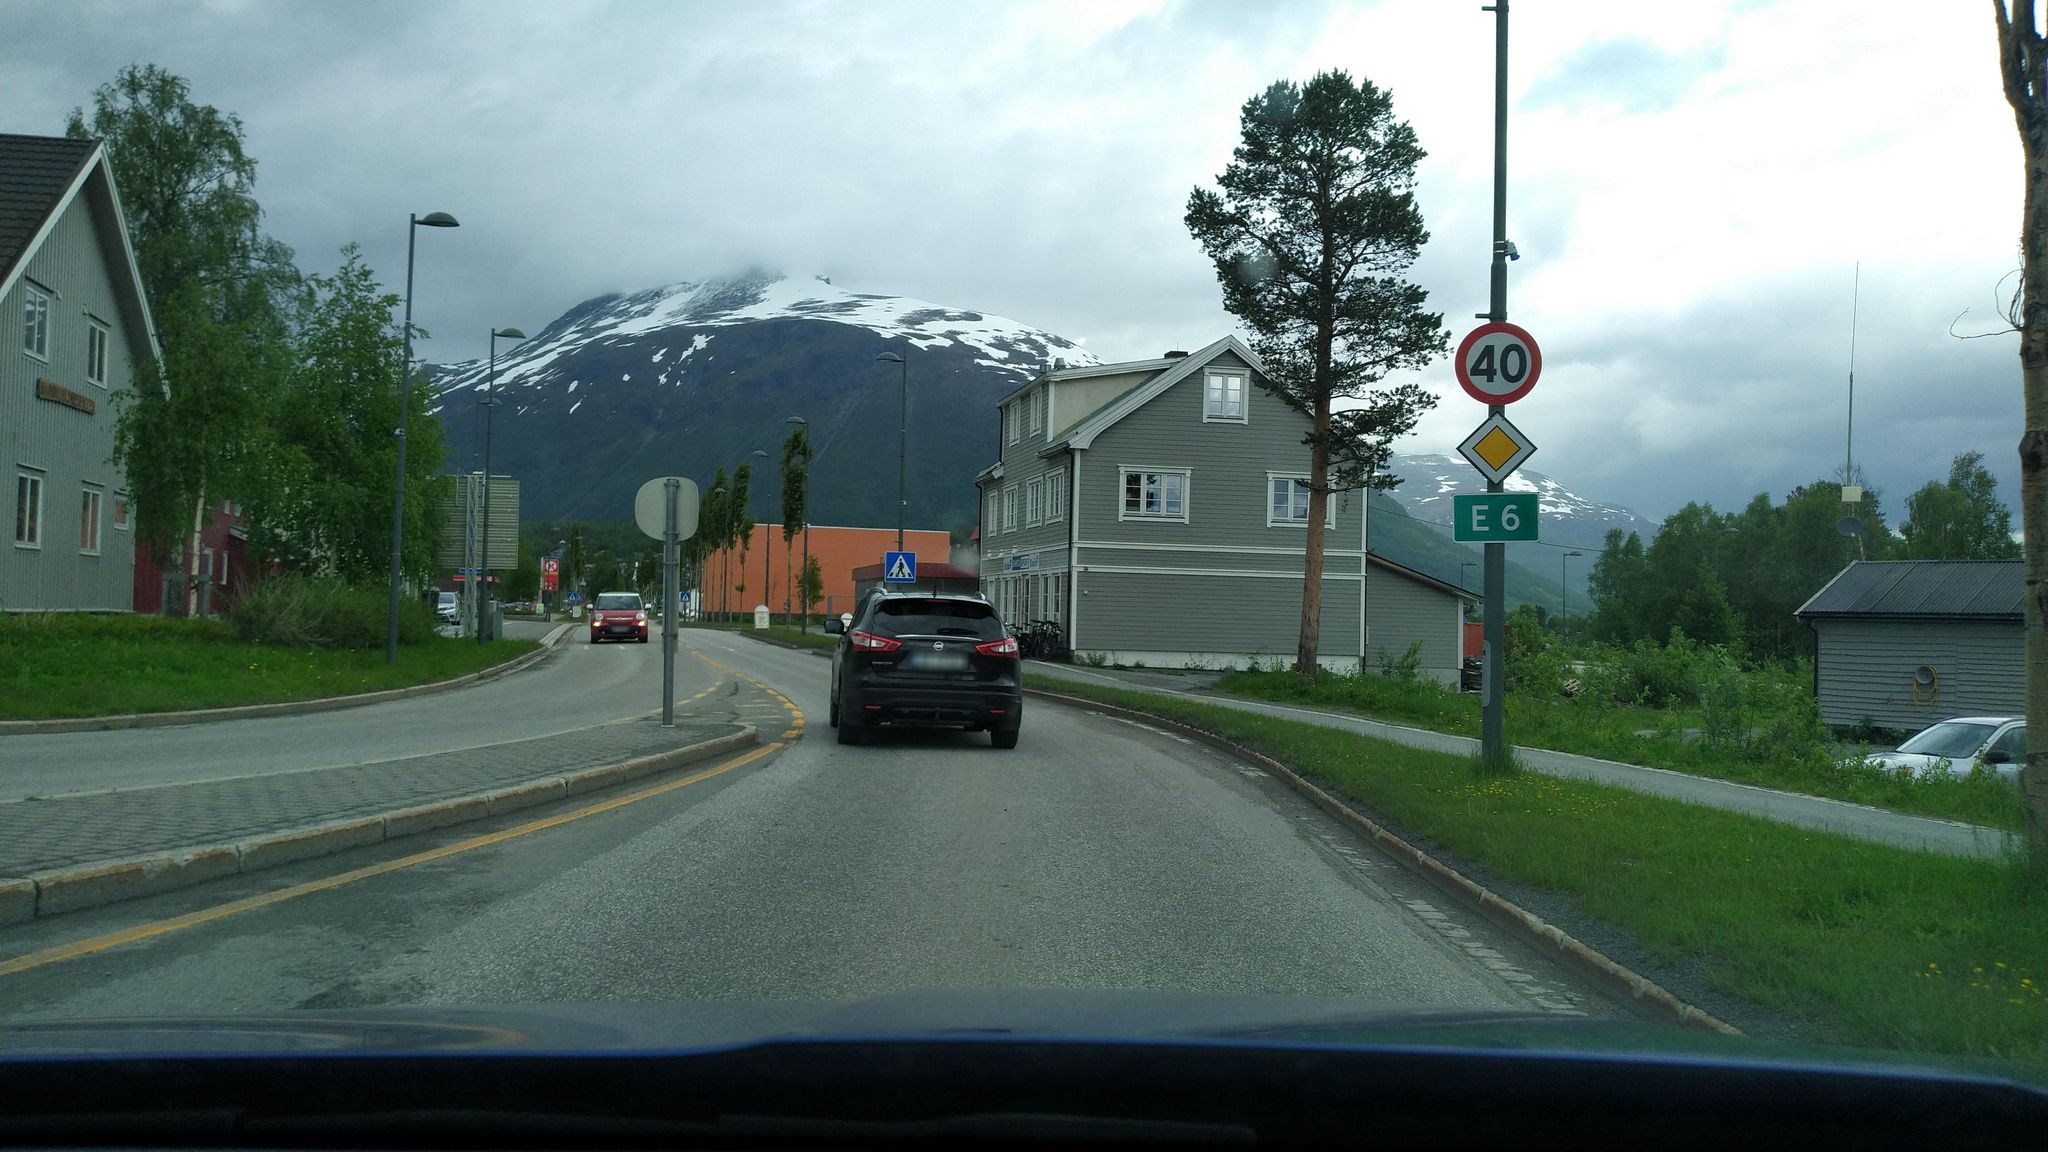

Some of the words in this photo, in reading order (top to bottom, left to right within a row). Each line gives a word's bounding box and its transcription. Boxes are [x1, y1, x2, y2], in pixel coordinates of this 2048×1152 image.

[1470, 343, 1527, 383] 40
[1472, 505, 1489, 531] E
[1501, 504, 1520, 531] 6
